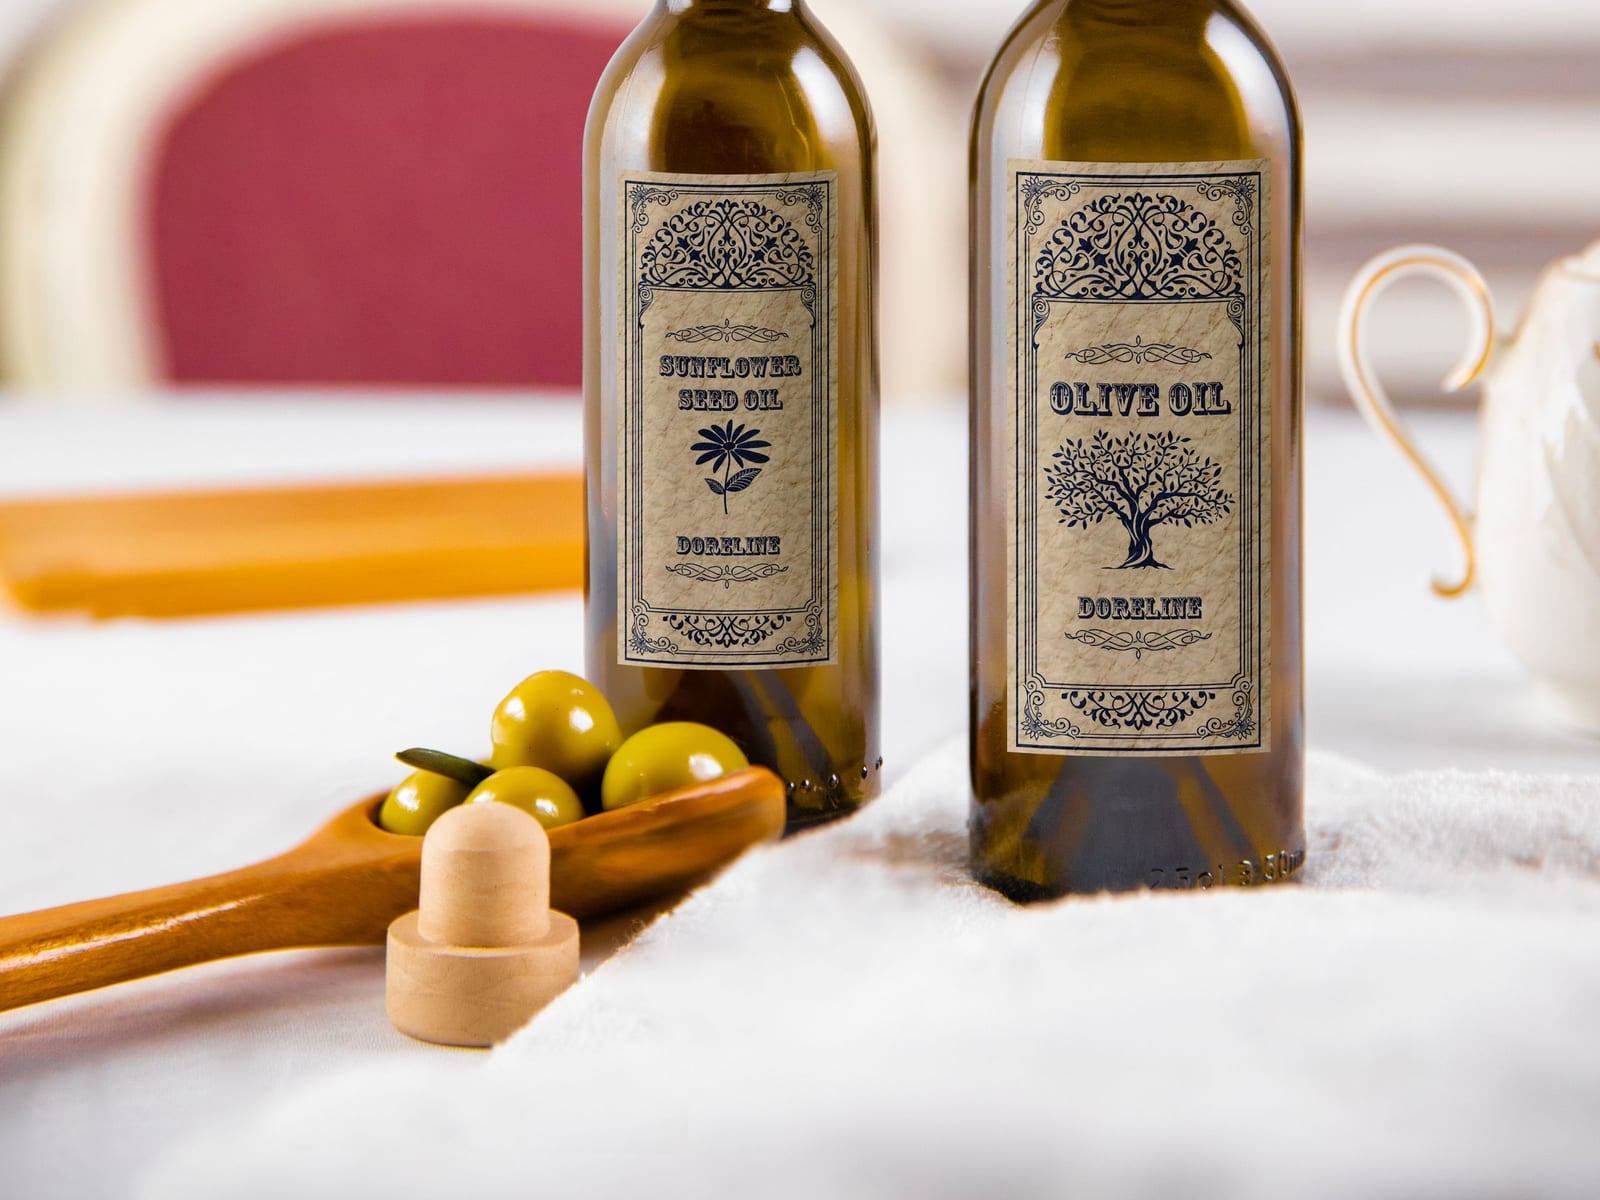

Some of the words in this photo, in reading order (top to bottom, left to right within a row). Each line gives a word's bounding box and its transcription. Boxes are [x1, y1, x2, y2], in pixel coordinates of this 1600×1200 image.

[659, 355, 801, 378] SUNFLOWER
[678, 388, 738, 410] SEED
[744, 388, 783, 410] OIL
[1050, 381, 1160, 416] OLIVE
[1168, 381, 1231, 416] OIL
[676, 536, 780, 555] DORELINE
[1078, 597, 1202, 619] DORELINE
